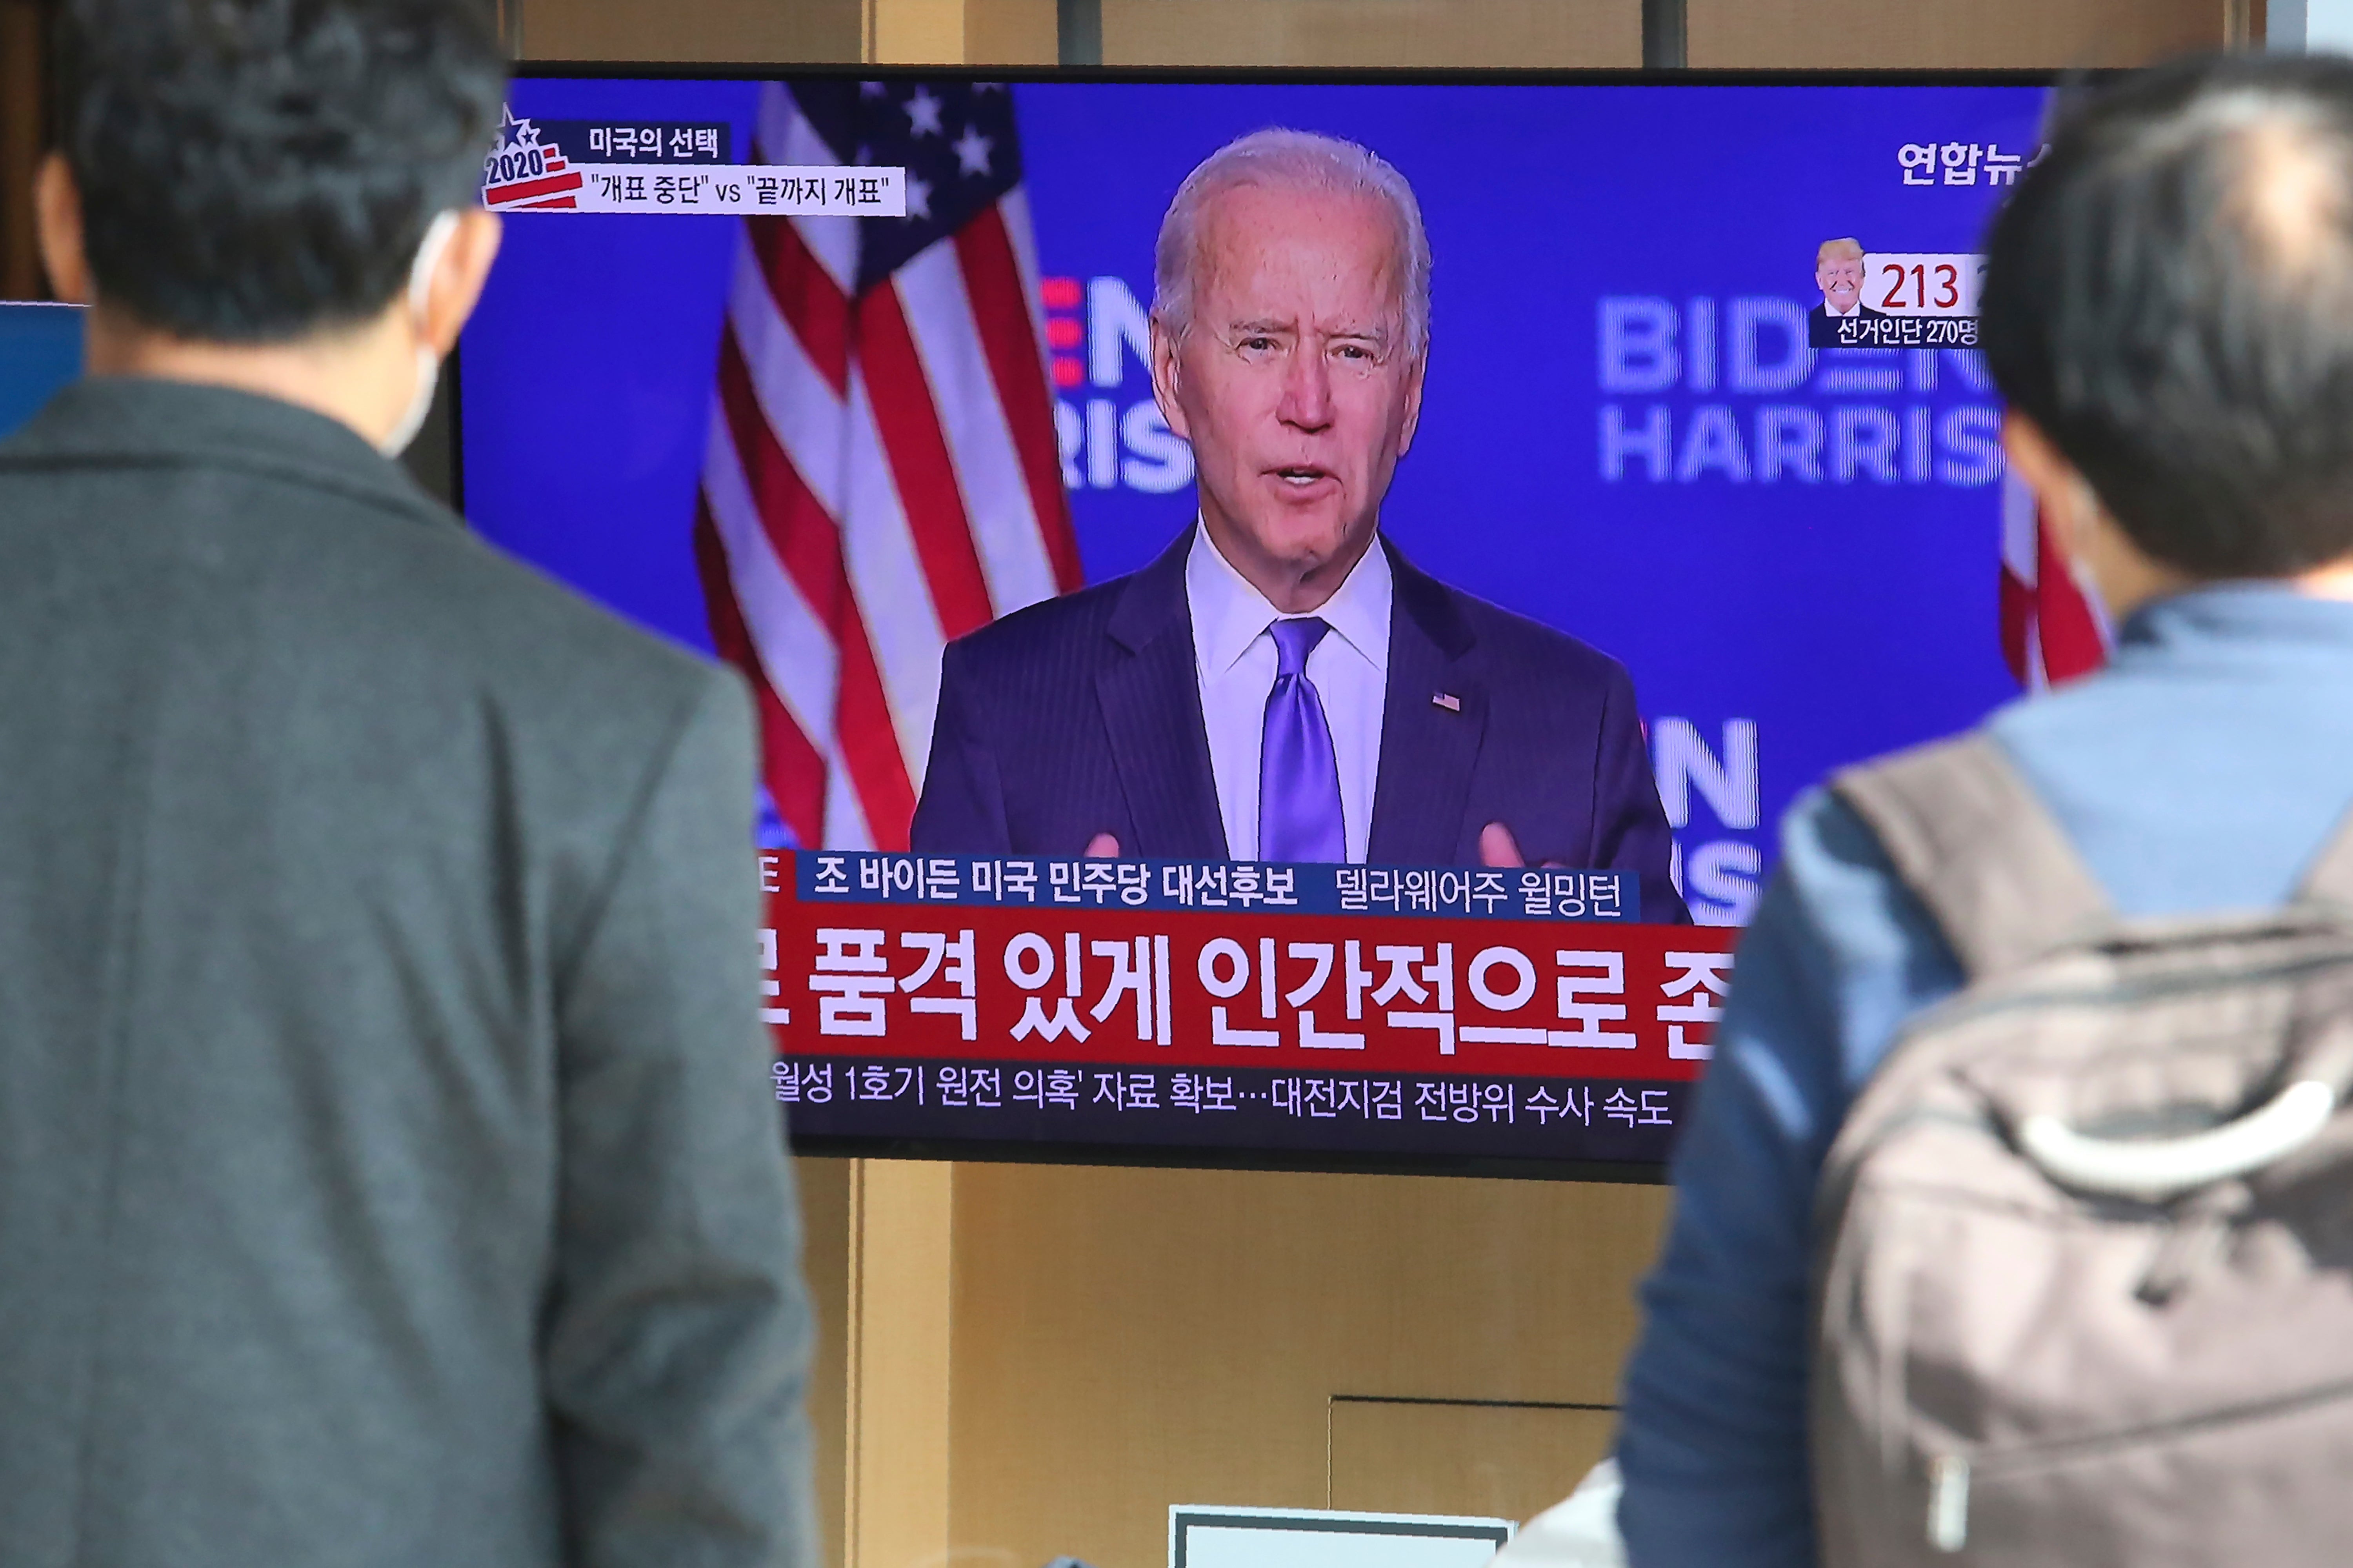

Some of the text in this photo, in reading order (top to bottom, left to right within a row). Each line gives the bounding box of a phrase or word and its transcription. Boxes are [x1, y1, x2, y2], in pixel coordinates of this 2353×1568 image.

[589, 127, 718, 158] 미국의 선택
[1897, 142, 2052, 186] 연합뉴
[486, 149, 543, 184] 2020
[591, 173, 889, 206] "개표 중단" vs "끝까지 개표"
[1882, 264, 1958, 308] 213
[1837, 318, 1978, 345] 선거인단 270명
[1599, 405, 2006, 485] HARRIS
[815, 857, 849, 893] 조
[860, 858, 960, 899] 바이든
[972, 860, 1038, 902] 미국
[1049, 861, 1151, 905] 민주당
[1162, 865, 1298, 907] 대선후보
[1336, 868, 1508, 914] 델라웨어주
[809, 928, 977, 1041] 품격
[1004, 932, 1171, 1046] 있게
[1197, 937, 1637, 1055] 인간적으로
[769, 1061, 832, 1103] 월성
[845, 1065, 924, 1105] 1호기
[936, 1067, 1001, 1107] 원전
[1092, 1071, 1160, 1112] 자료
[1415, 1081, 1514, 1124] 전방위
[1525, 1086, 1595, 1126] 수사
[1603, 1087, 1673, 1128] 속도
